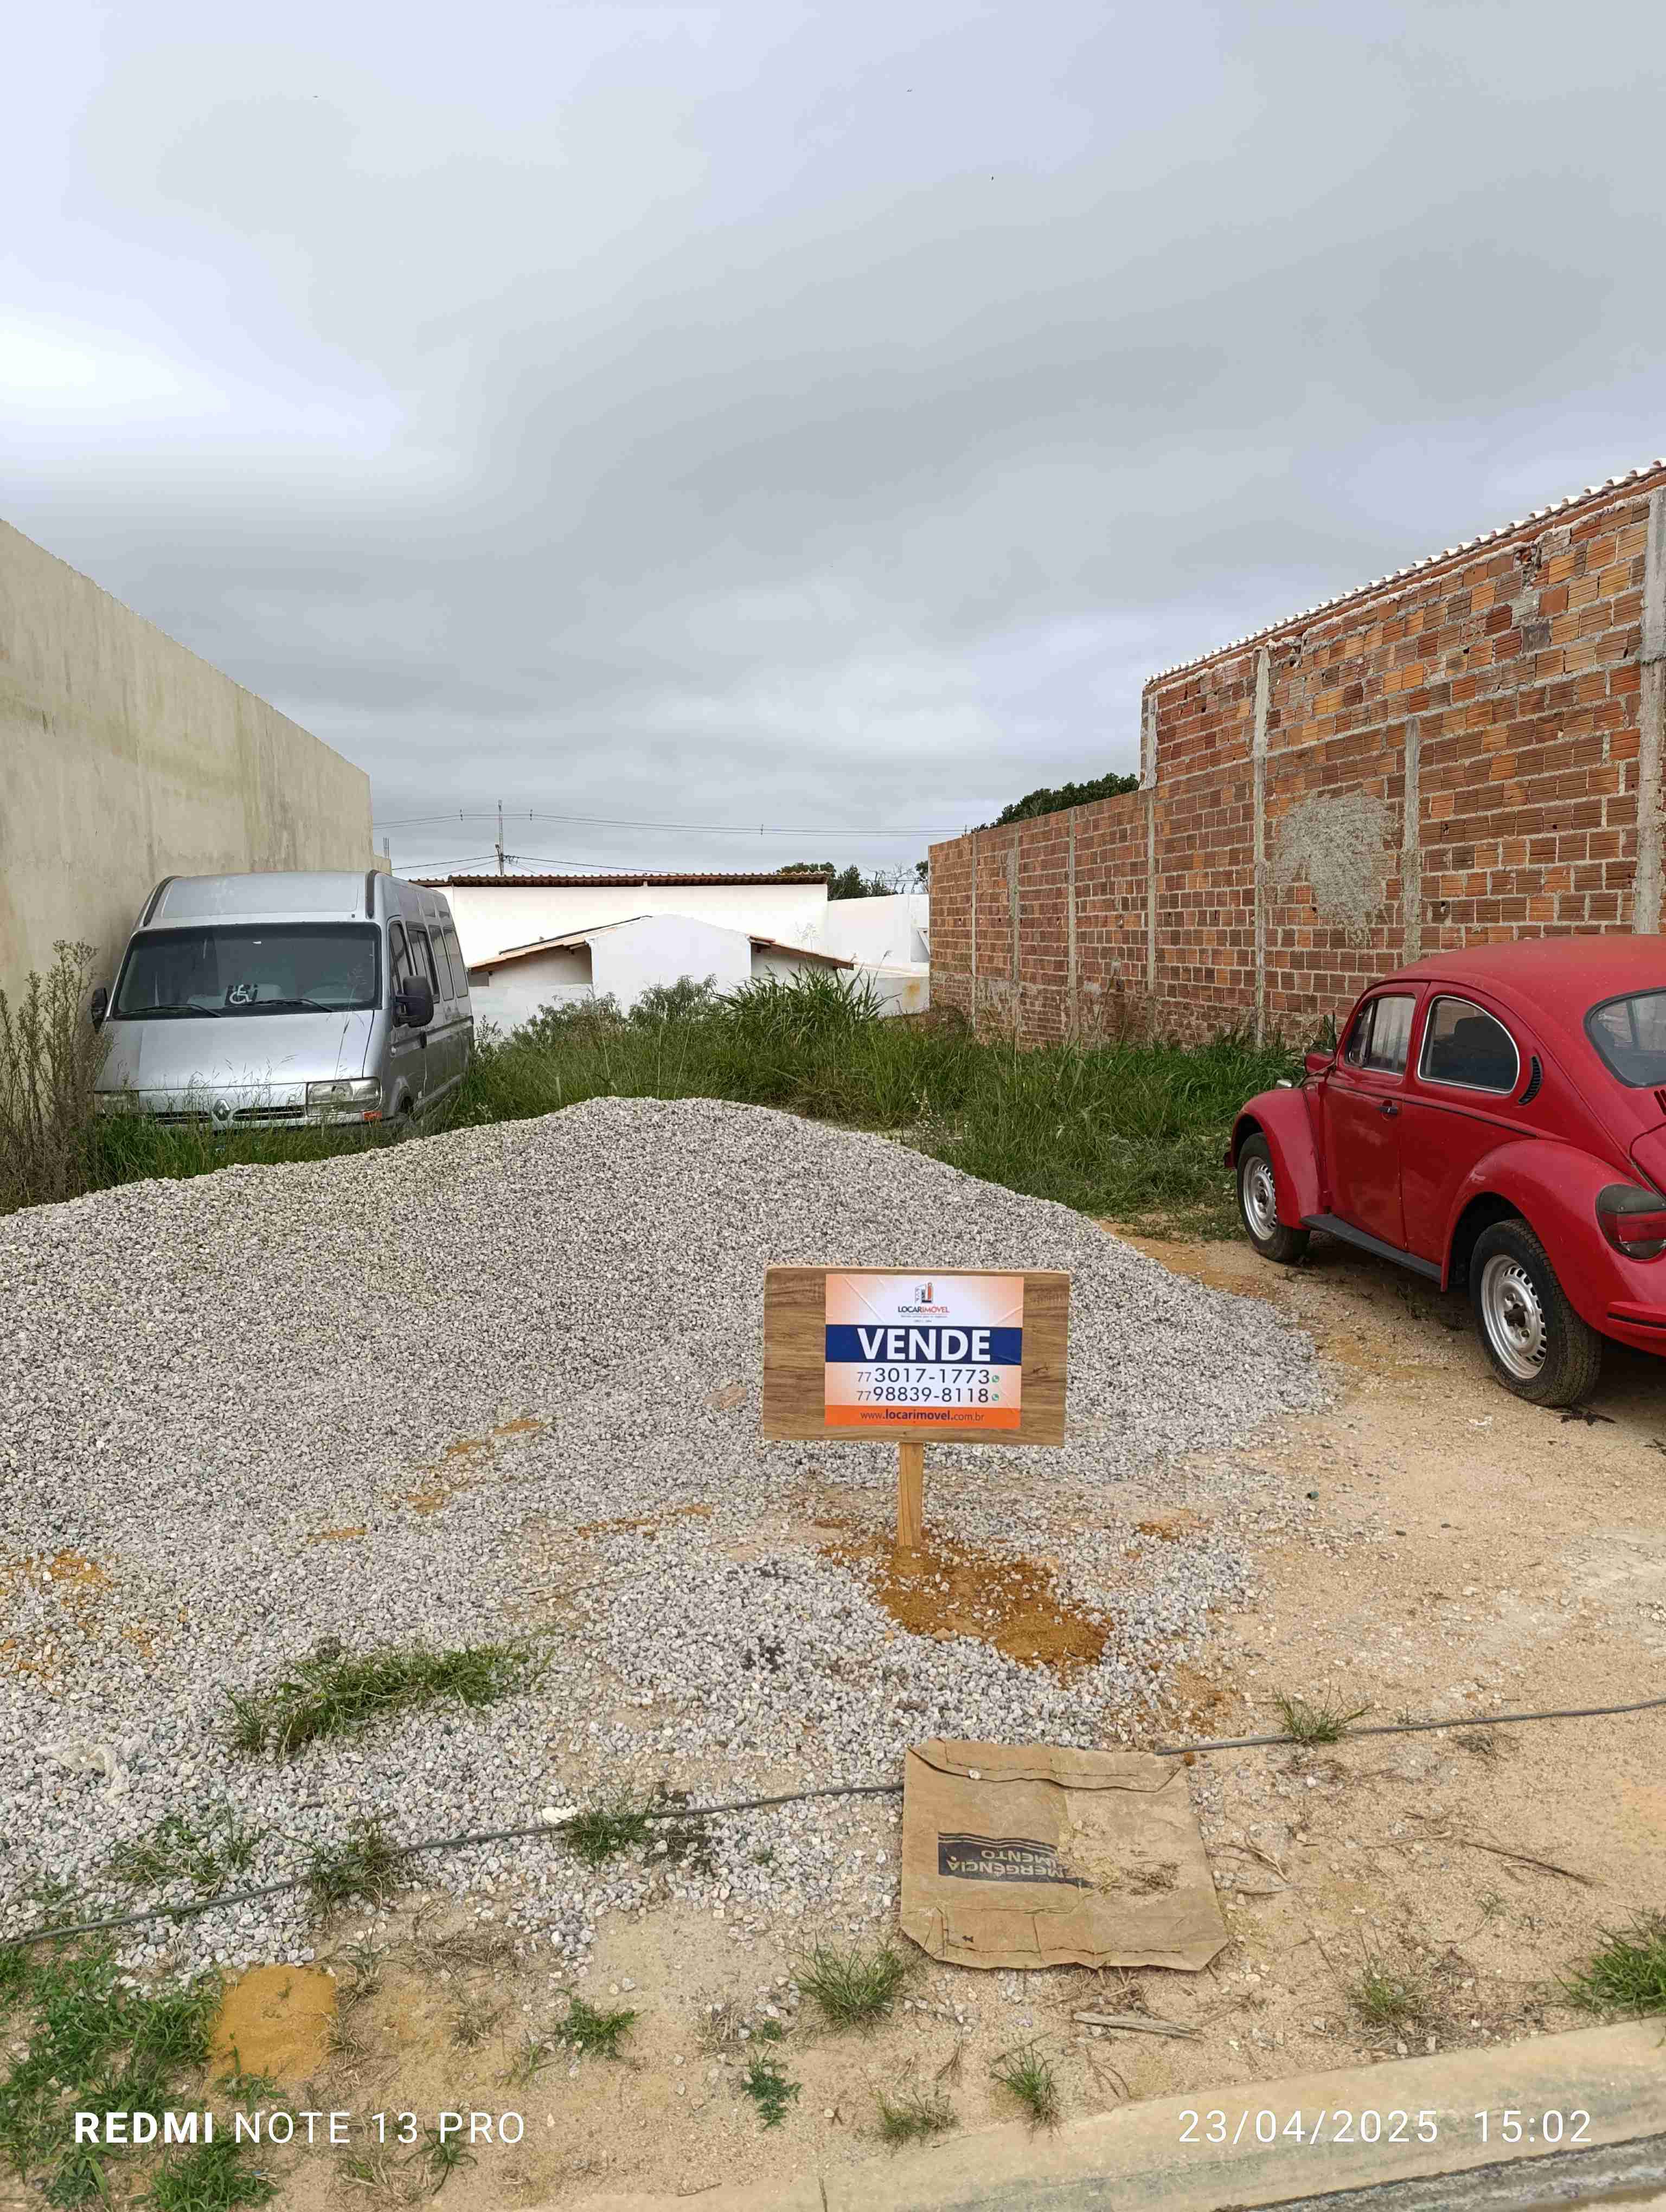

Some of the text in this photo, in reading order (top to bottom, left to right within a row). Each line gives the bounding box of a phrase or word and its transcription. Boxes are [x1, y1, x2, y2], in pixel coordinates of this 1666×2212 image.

[857, 1328, 991, 1361] VENDE
[857, 1367, 990, 1384] 77 3017-1773
[857, 1387, 989, 1403] 77 98839-8118
[860, 1409, 984, 1422] www.locarimovel.com.br
